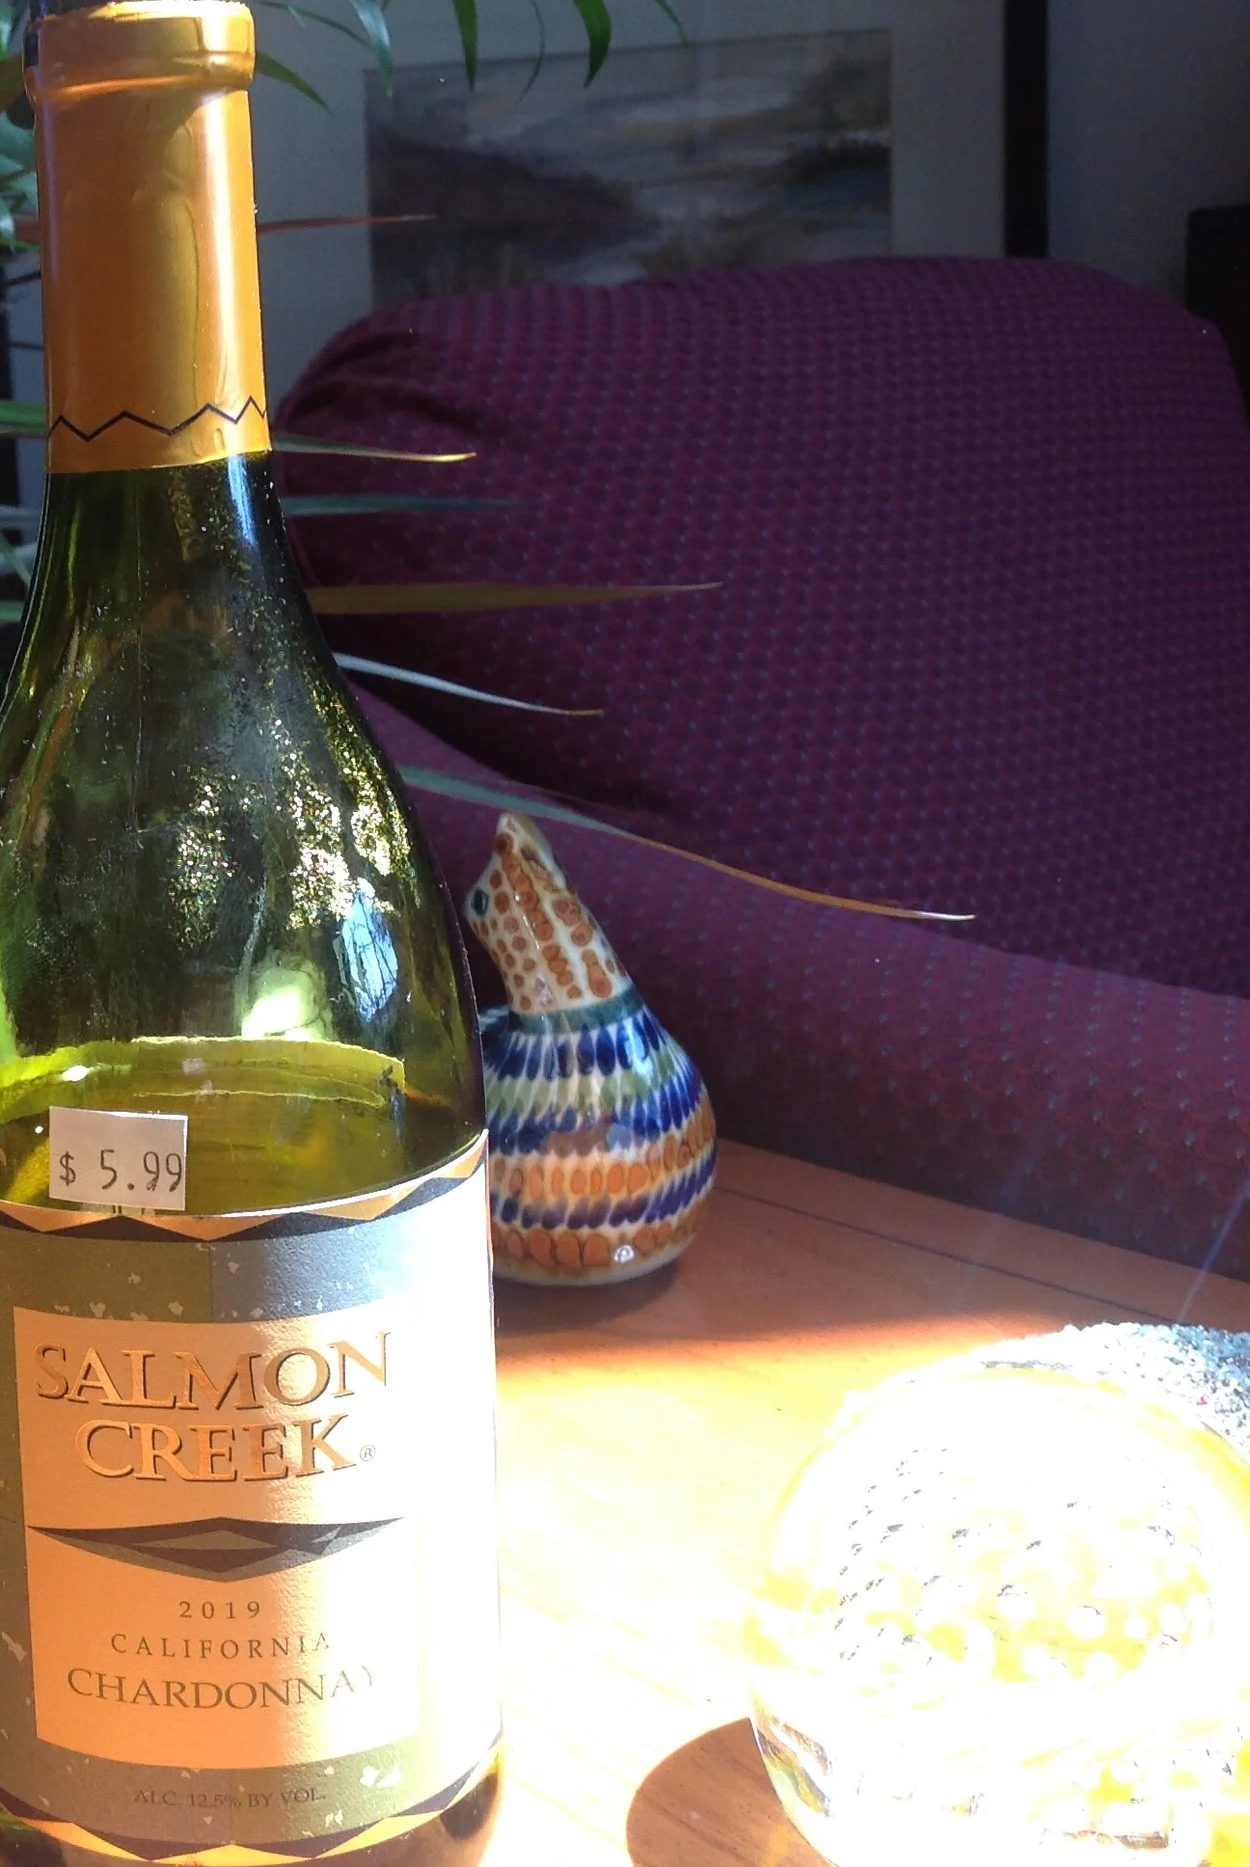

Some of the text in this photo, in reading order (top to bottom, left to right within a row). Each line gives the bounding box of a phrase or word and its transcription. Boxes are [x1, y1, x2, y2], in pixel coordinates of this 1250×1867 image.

[100, 1149, 182, 1192] 5.99
[34, 1330, 391, 1411] SALMON
[74, 1412, 357, 1482] CREEK
[178, 1600, 261, 1619] 2019
[110, 1631, 330, 1660] CALIFORNIA
[66, 1663, 374, 1709] CHARDONNAY
[189, 1793, 242, 1809] 12.5%
[247, 1792, 274, 1808] BY
